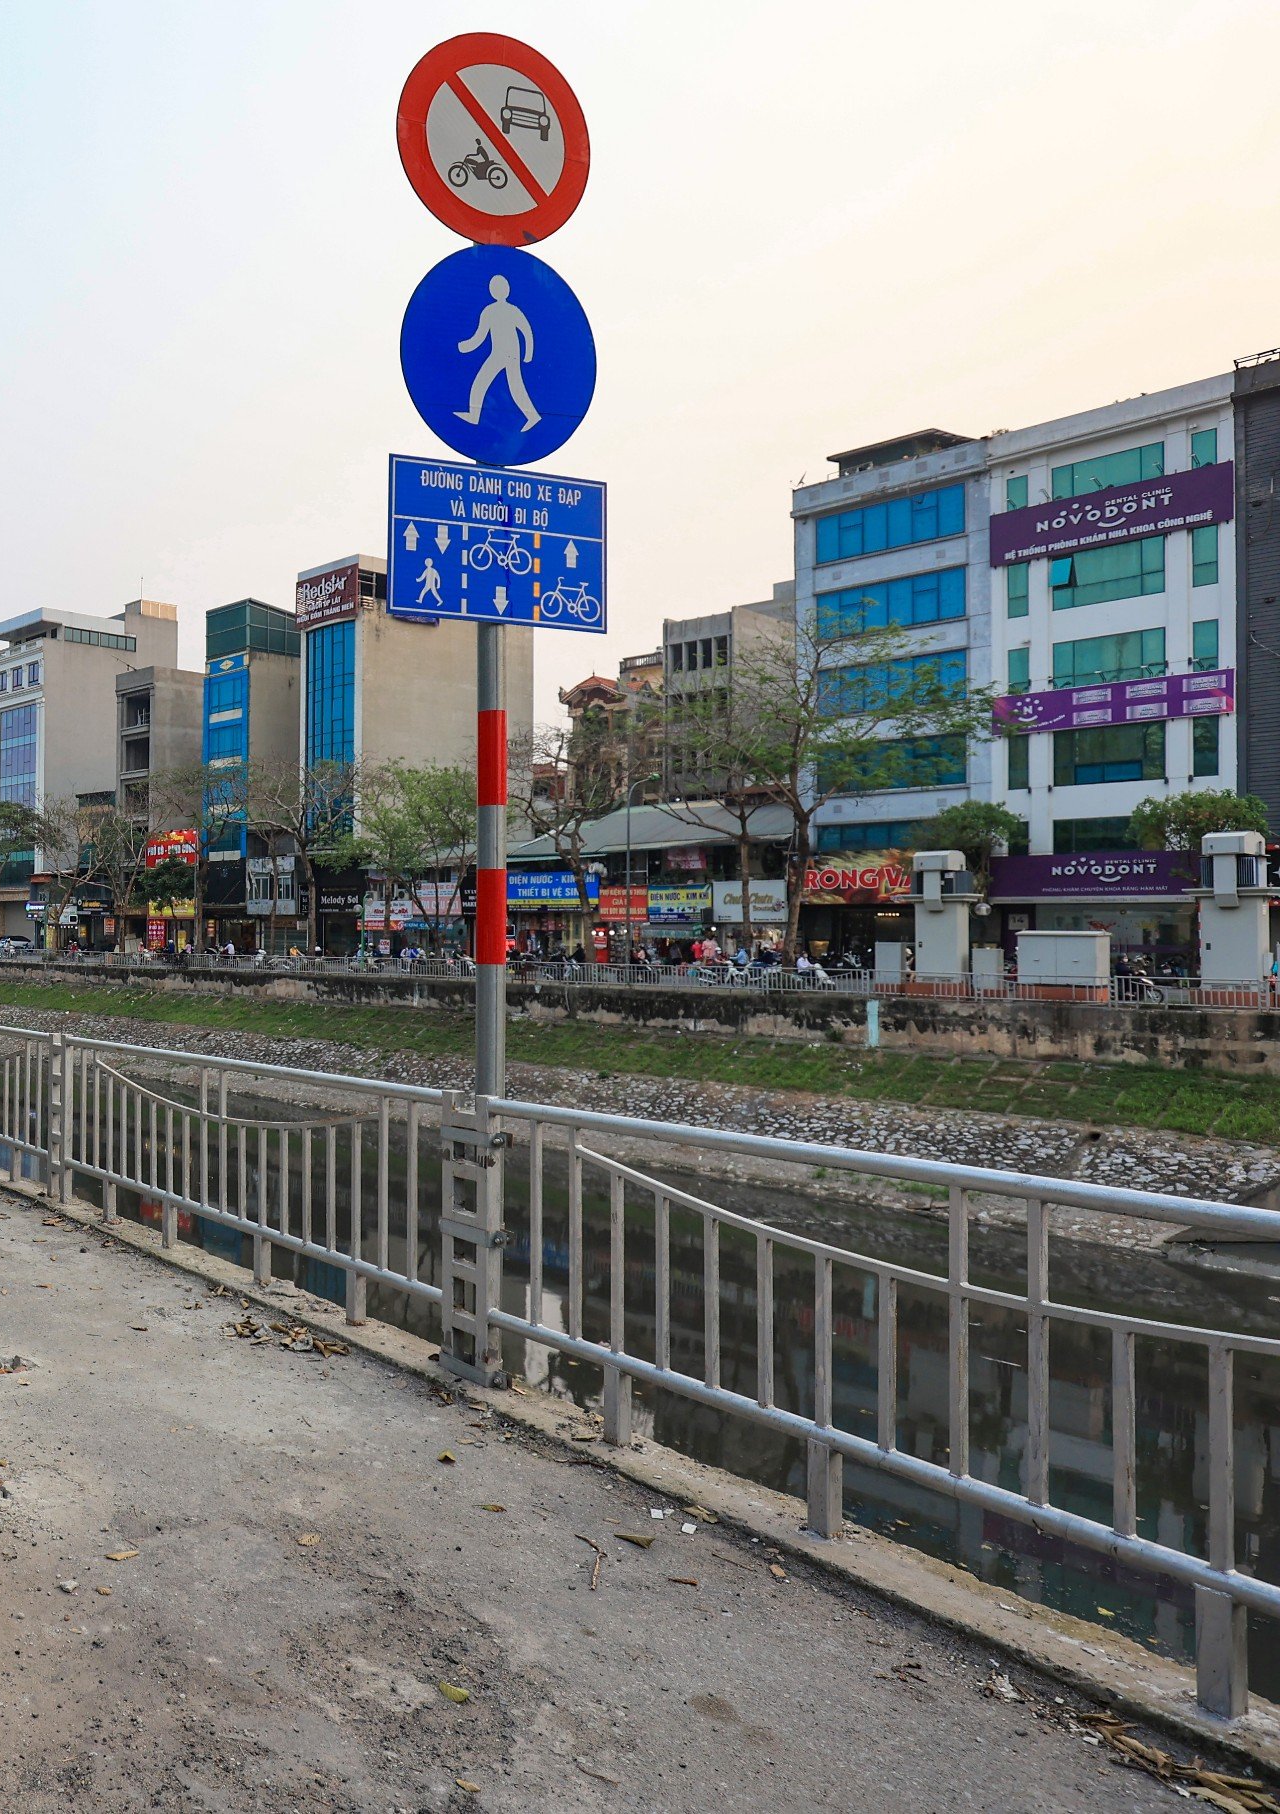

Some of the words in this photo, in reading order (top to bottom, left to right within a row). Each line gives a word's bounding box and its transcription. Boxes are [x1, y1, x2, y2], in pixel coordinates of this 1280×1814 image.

[420, 467, 463, 490] ĐƯỜNG
[469, 472, 502, 495] DÀNH
[507, 481, 531, 499] CHO
[537, 485, 552, 502] XE
[558, 487, 582, 509] ĐẠP
[1104, 494, 1138, 506] DENTAL
[1141, 487, 1172, 498] CLINIC
[450, 495, 466, 518] VÀ
[472, 501, 509, 523] NGƯỜI
[514, 507, 526, 525] ĐI
[532, 507, 549, 530] BỘ
[1035, 493, 1173, 533] NOVODONT
[1004, 550, 1017, 561] HỆ
[1108, 529, 1129, 539] NHA
[1129, 523, 1156, 535] KHOA
[1157, 517, 1184, 529] CÔNG
[1185, 510, 1214, 524] NGHỆ
[1051, 864, 1157, 876] NOVODONT
[508, 874, 528, 886] ĐIỆN
[320, 895, 346, 906] Melody
[347, 895, 359, 904] Sol
[517, 886, 539, 897] THIẾT
